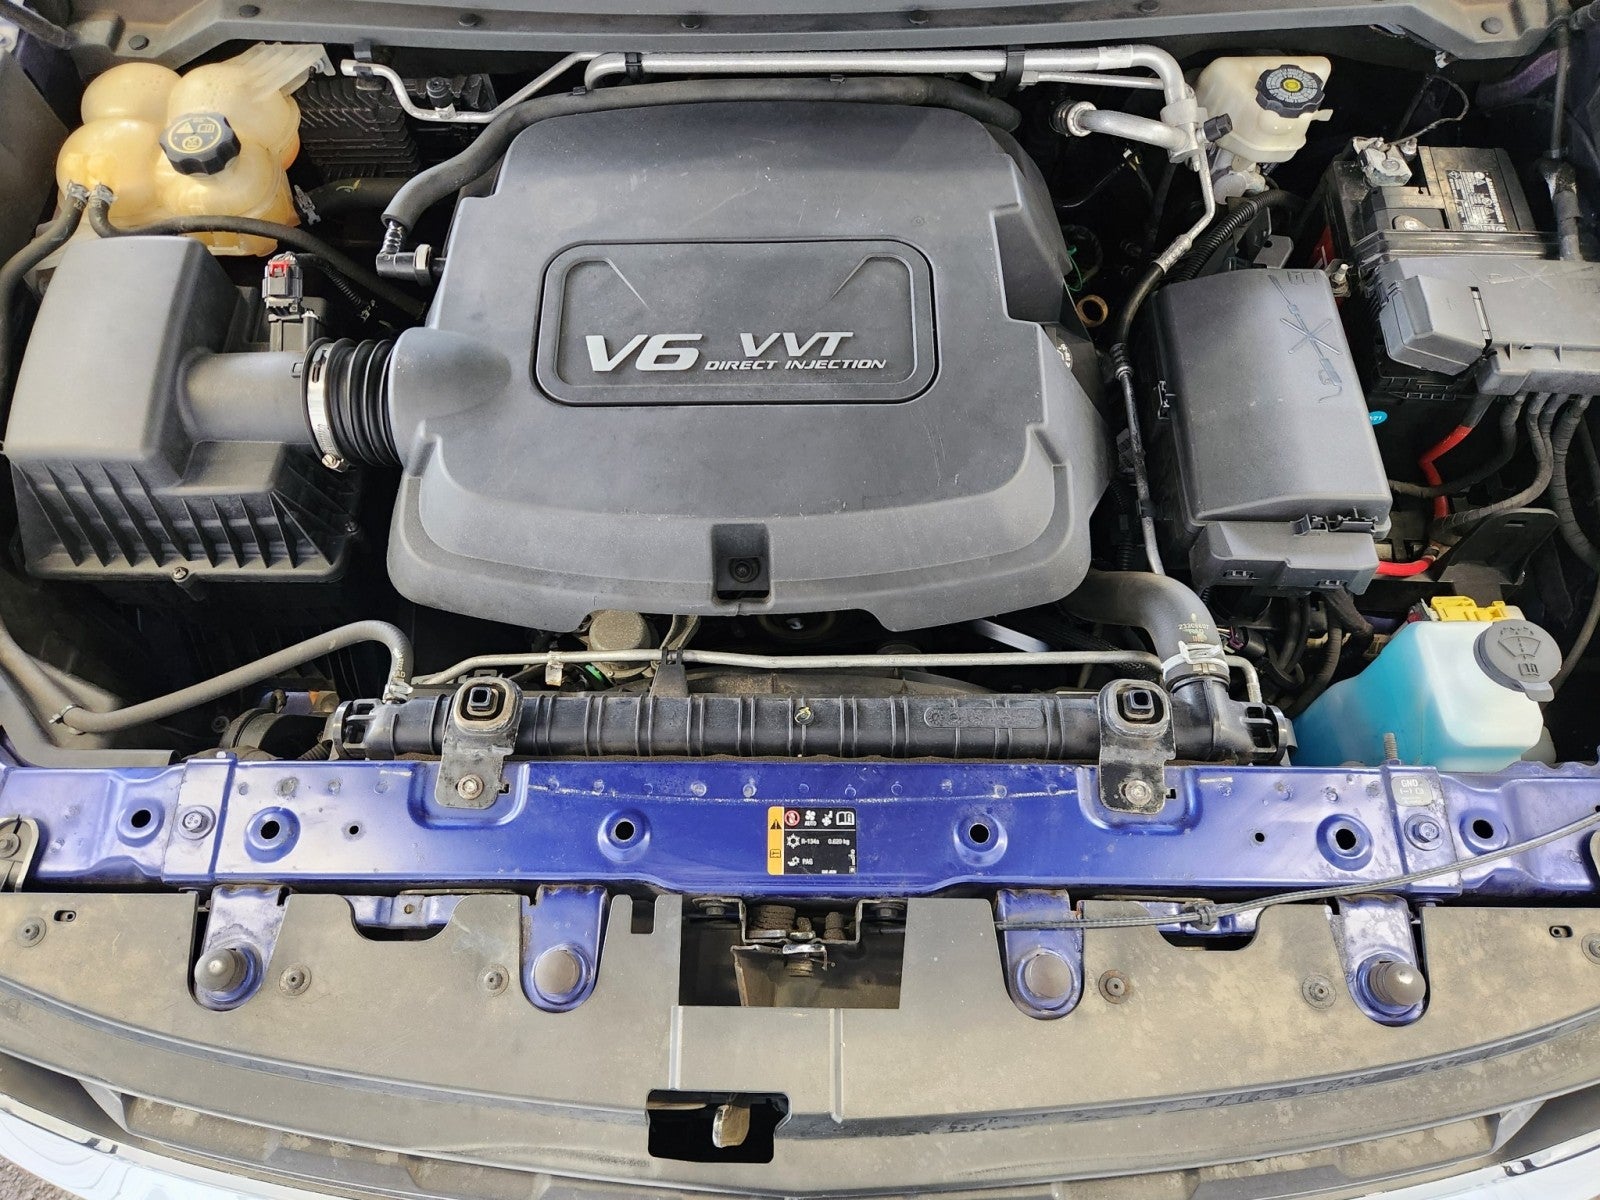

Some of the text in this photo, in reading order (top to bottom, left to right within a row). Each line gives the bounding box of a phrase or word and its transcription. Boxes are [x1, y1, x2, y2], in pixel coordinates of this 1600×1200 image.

[585, 332, 854, 372] V6 VVT
[704, 359, 887, 370] DIRECT INJECTION
[1400, 779, 1419, 788] GND
